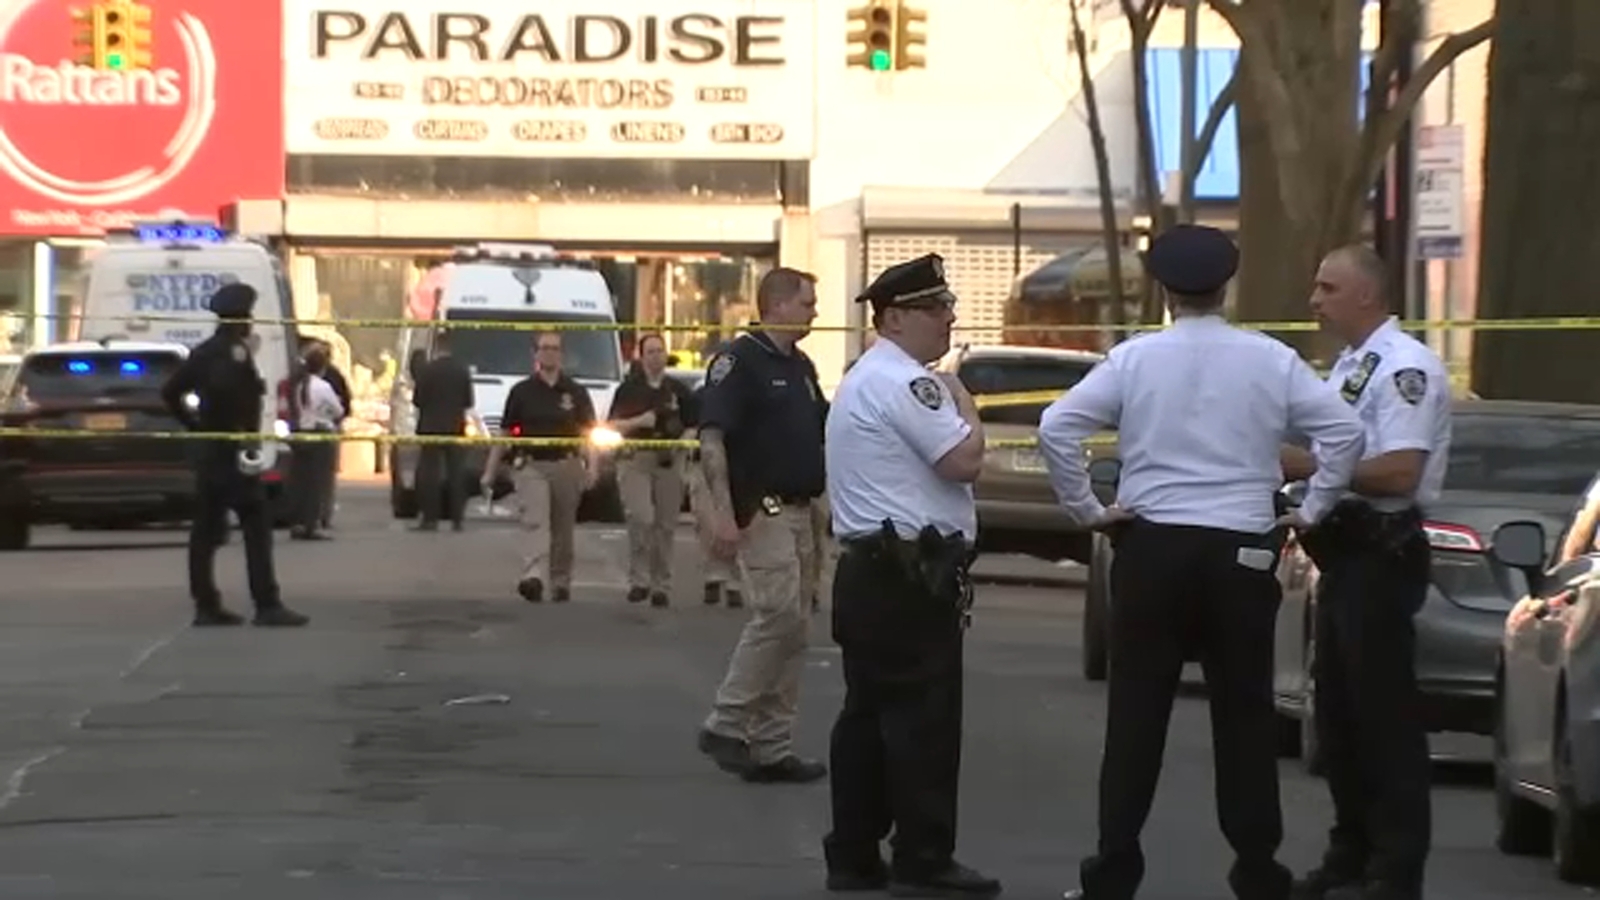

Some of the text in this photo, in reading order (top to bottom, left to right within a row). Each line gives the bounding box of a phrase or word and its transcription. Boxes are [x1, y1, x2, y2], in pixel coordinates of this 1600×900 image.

[311, 10, 787, 67] PARADISE
[2, 53, 181, 105] Rattans
[422, 77, 674, 108] DECORATORS
[517, 121, 584, 140] DRAPES
[615, 122, 682, 141] LINENS
[149, 274, 217, 291] NYPD
[133, 293, 212, 311] POLIC
